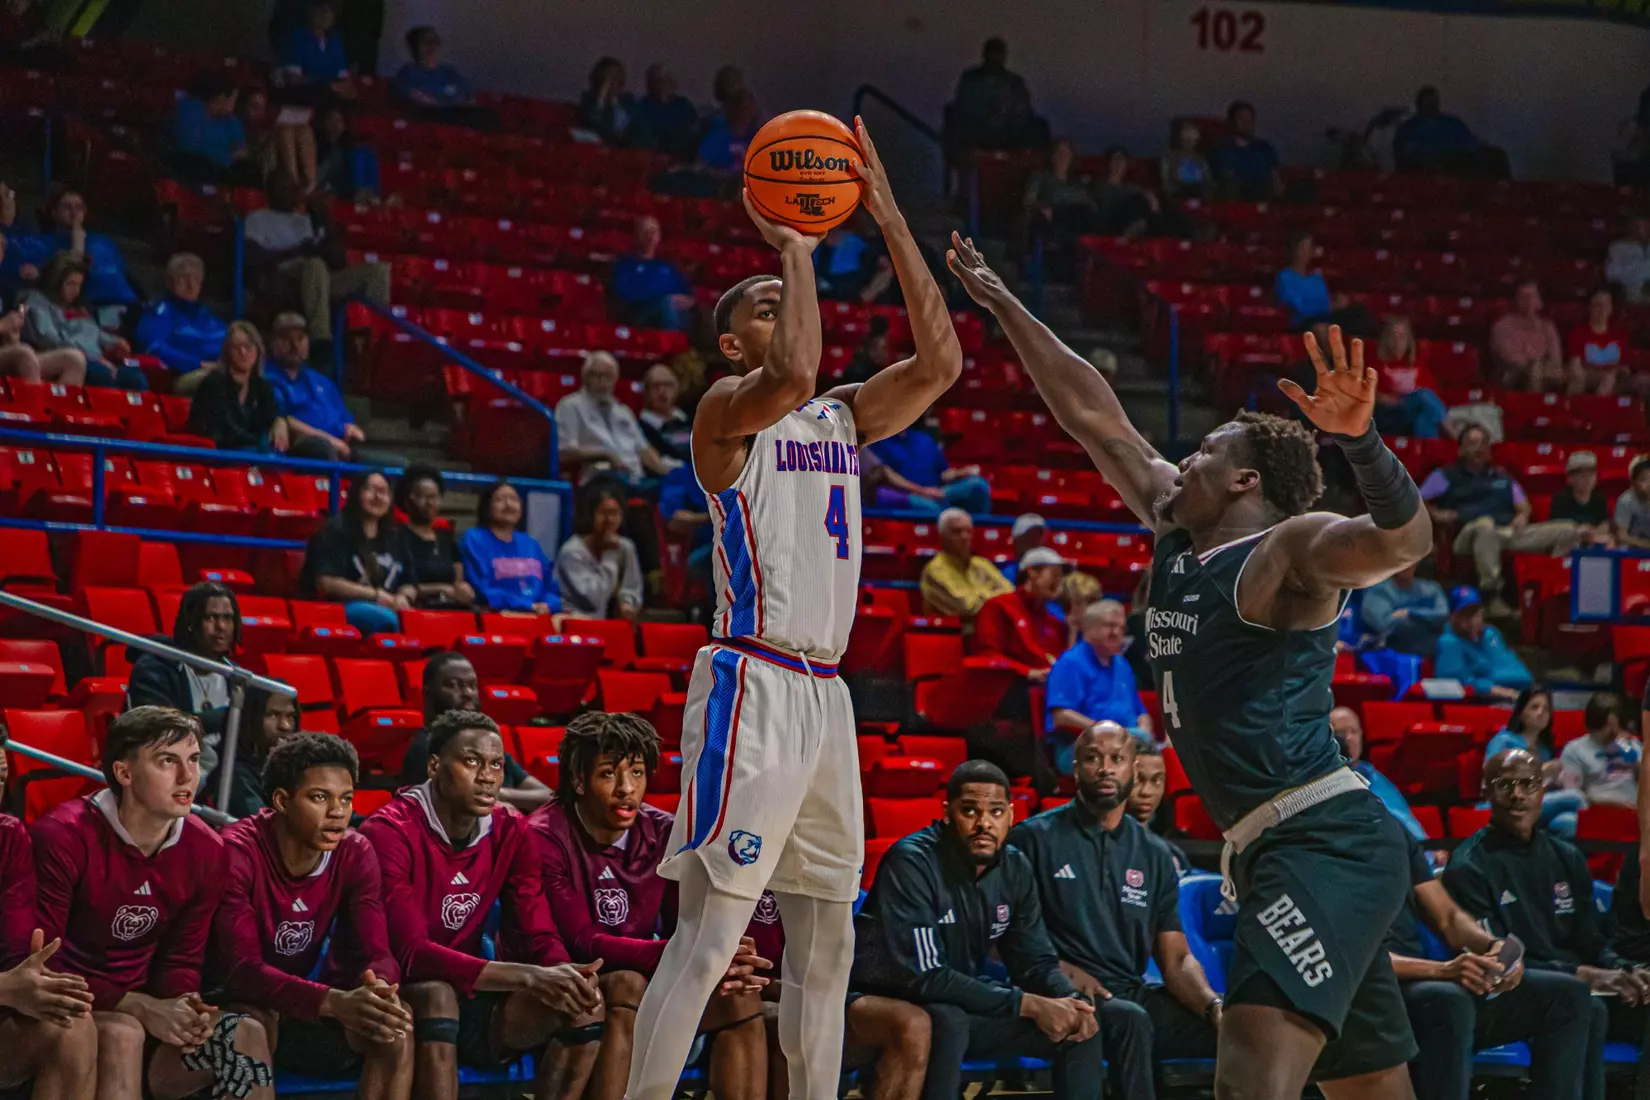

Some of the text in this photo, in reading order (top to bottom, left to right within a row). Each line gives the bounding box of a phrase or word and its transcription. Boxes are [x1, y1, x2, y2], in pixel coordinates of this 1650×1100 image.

[1190, 8, 1265, 51] 102
[769, 149, 850, 172] Wilson
[824, 485, 849, 560] 4
[1150, 632, 1183, 659] State
[1163, 671, 1181, 728] 4
[1256, 893, 1333, 987] BEARS
